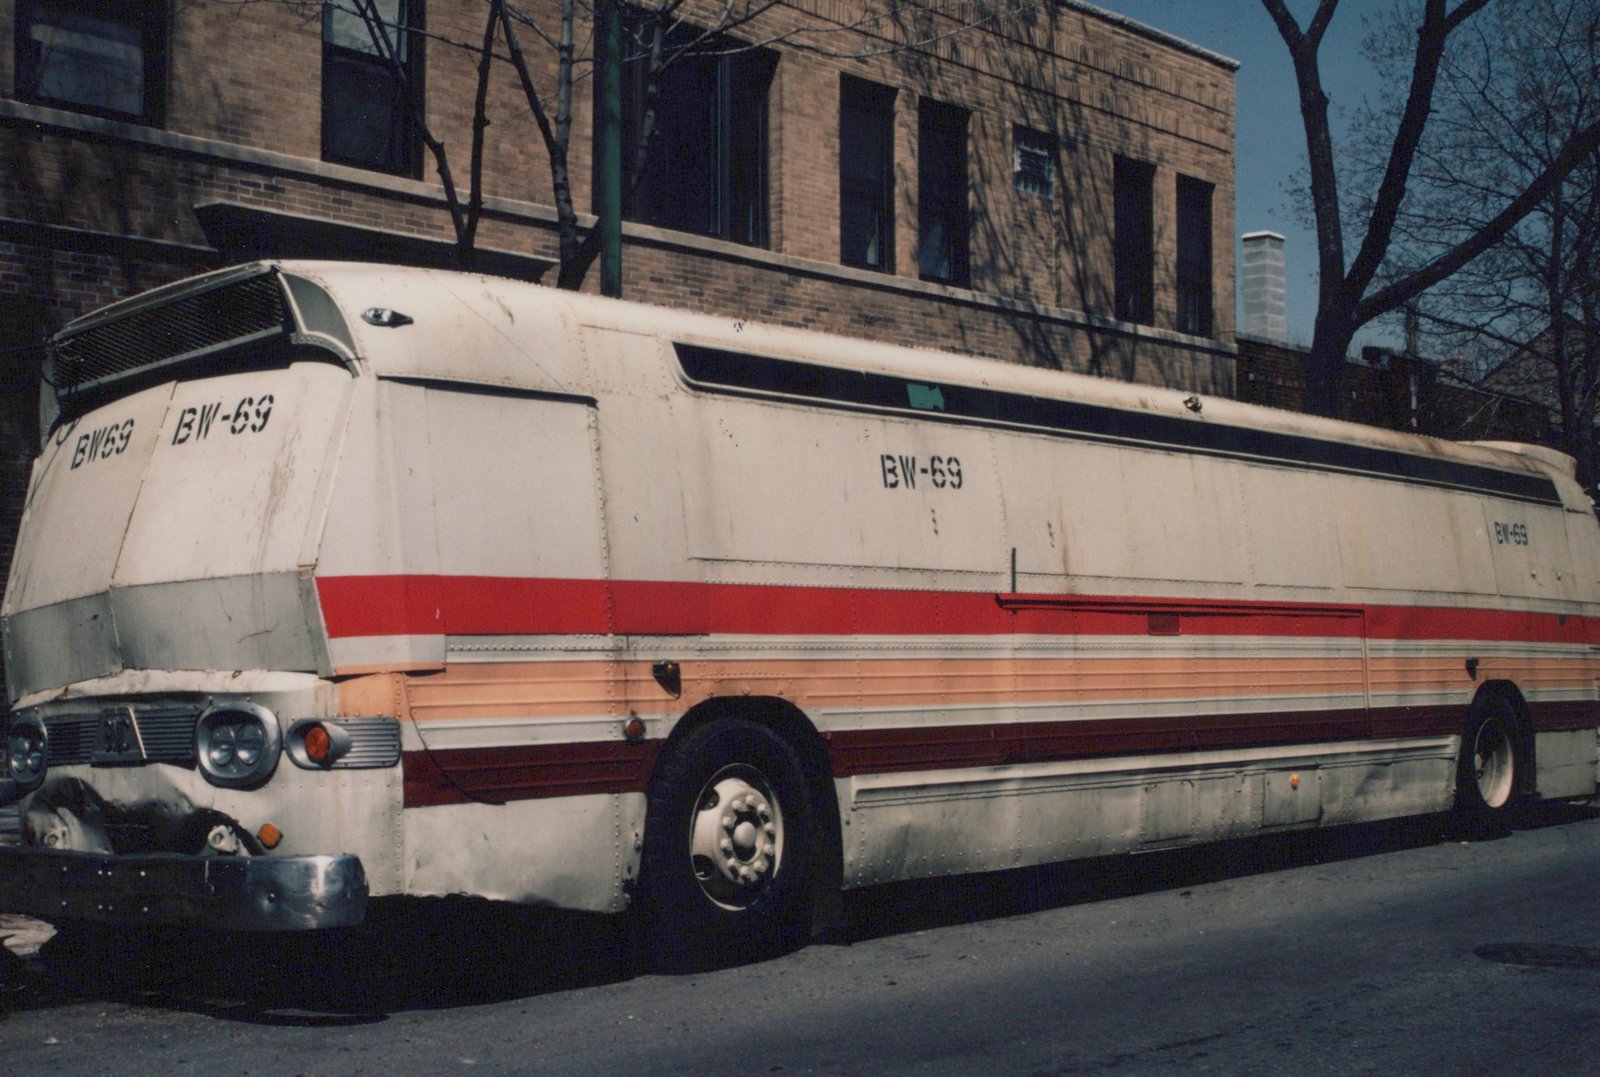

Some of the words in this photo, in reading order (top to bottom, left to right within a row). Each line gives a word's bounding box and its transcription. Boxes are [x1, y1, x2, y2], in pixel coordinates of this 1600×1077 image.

[171, 394, 275, 446] BW-69
[71, 418, 135, 470] BW69
[880, 454, 963, 489] BW-69
[1494, 521, 1528, 546] BW-69
